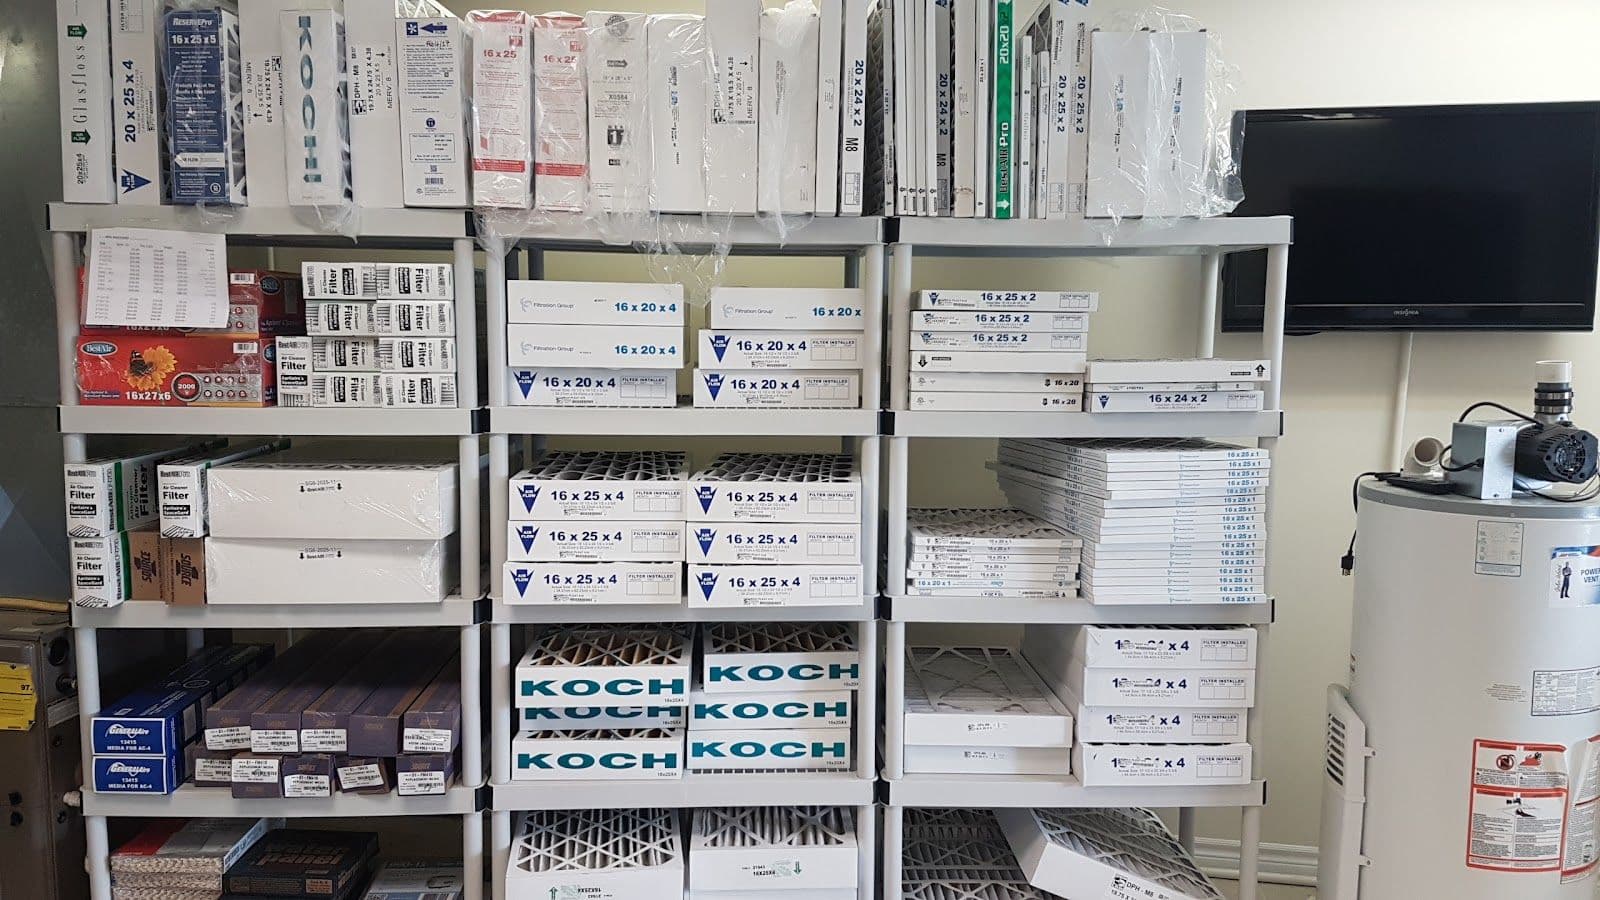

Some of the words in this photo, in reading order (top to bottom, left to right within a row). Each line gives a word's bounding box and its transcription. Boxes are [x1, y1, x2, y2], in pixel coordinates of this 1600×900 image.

[172, 35, 183, 44] 16
[190, 35, 202, 44] 25
[210, 35, 216, 43] 5
[504, 50, 516, 58] 25
[122, 60, 133, 69] 4
[353, 65, 359, 75] M8
[855, 60, 864, 75] 20
[71, 46, 87, 123] Glasfloss
[126, 74, 134, 83] x
[940, 73, 948, 87] 20
[1059, 76, 1066, 88] 20
[1078, 76, 1085, 89] 20
[124, 88, 134, 106] 25
[299, 16, 317, 169] KOCH
[854, 89, 863, 104] 24
[940, 101, 948, 115] 24
[1058, 101, 1065, 114] 25
[1077, 103, 1084, 114] 25
[127, 111, 135, 119] x
[125, 125, 136, 142] 20
[845, 138, 858, 151] M8
[937, 153, 946, 166] M8
[329, 269, 337, 294] Filter
[1005, 293, 1018, 301] 25
[1030, 293, 1036, 301] 2
[615, 303, 628, 311] 16
[641, 303, 656, 312] 20
[669, 304, 676, 312] 4
[813, 308, 825, 316] 16
[838, 308, 852, 316] 20
[416, 306, 424, 330] Filter
[737, 341, 752, 350] 16
[768, 341, 783, 350] 20
[799, 341, 806, 350] 4
[351, 341, 359, 365] Filter
[418, 342, 426, 367] Filter
[543, 377, 559, 387] 16
[576, 378, 591, 387] 20
[607, 378, 615, 387] 4
[126, 391, 171, 400] 16x27x6
[351, 378, 359, 401] Filter
[1149, 394, 1162, 402] 16
[1175, 394, 1187, 402] 24
[70, 491, 95, 499] Filter
[551, 491, 567, 500] 16
[584, 491, 599, 500] 25
[616, 491, 624, 500] 4
[727, 492, 742, 501] 16
[759, 493, 774, 502] 25
[790, 493, 797, 502] 4
[77, 562, 102, 570] Filter
[544, 575, 560, 584] 16
[577, 575, 592, 584] 25
[609, 575, 617, 584] 4
[1584, 575, 1599, 583] VENT
[1181, 641, 1189, 650] 4
[710, 664, 859, 681] KOCH
[521, 679, 684, 696] KOCH
[1178, 679, 1187, 688] 4
[525, 706, 681, 720] KOCH
[694, 702, 847, 719] KOCH
[692, 742, 845, 758] KOCH
[518, 753, 677, 769] KOCH
